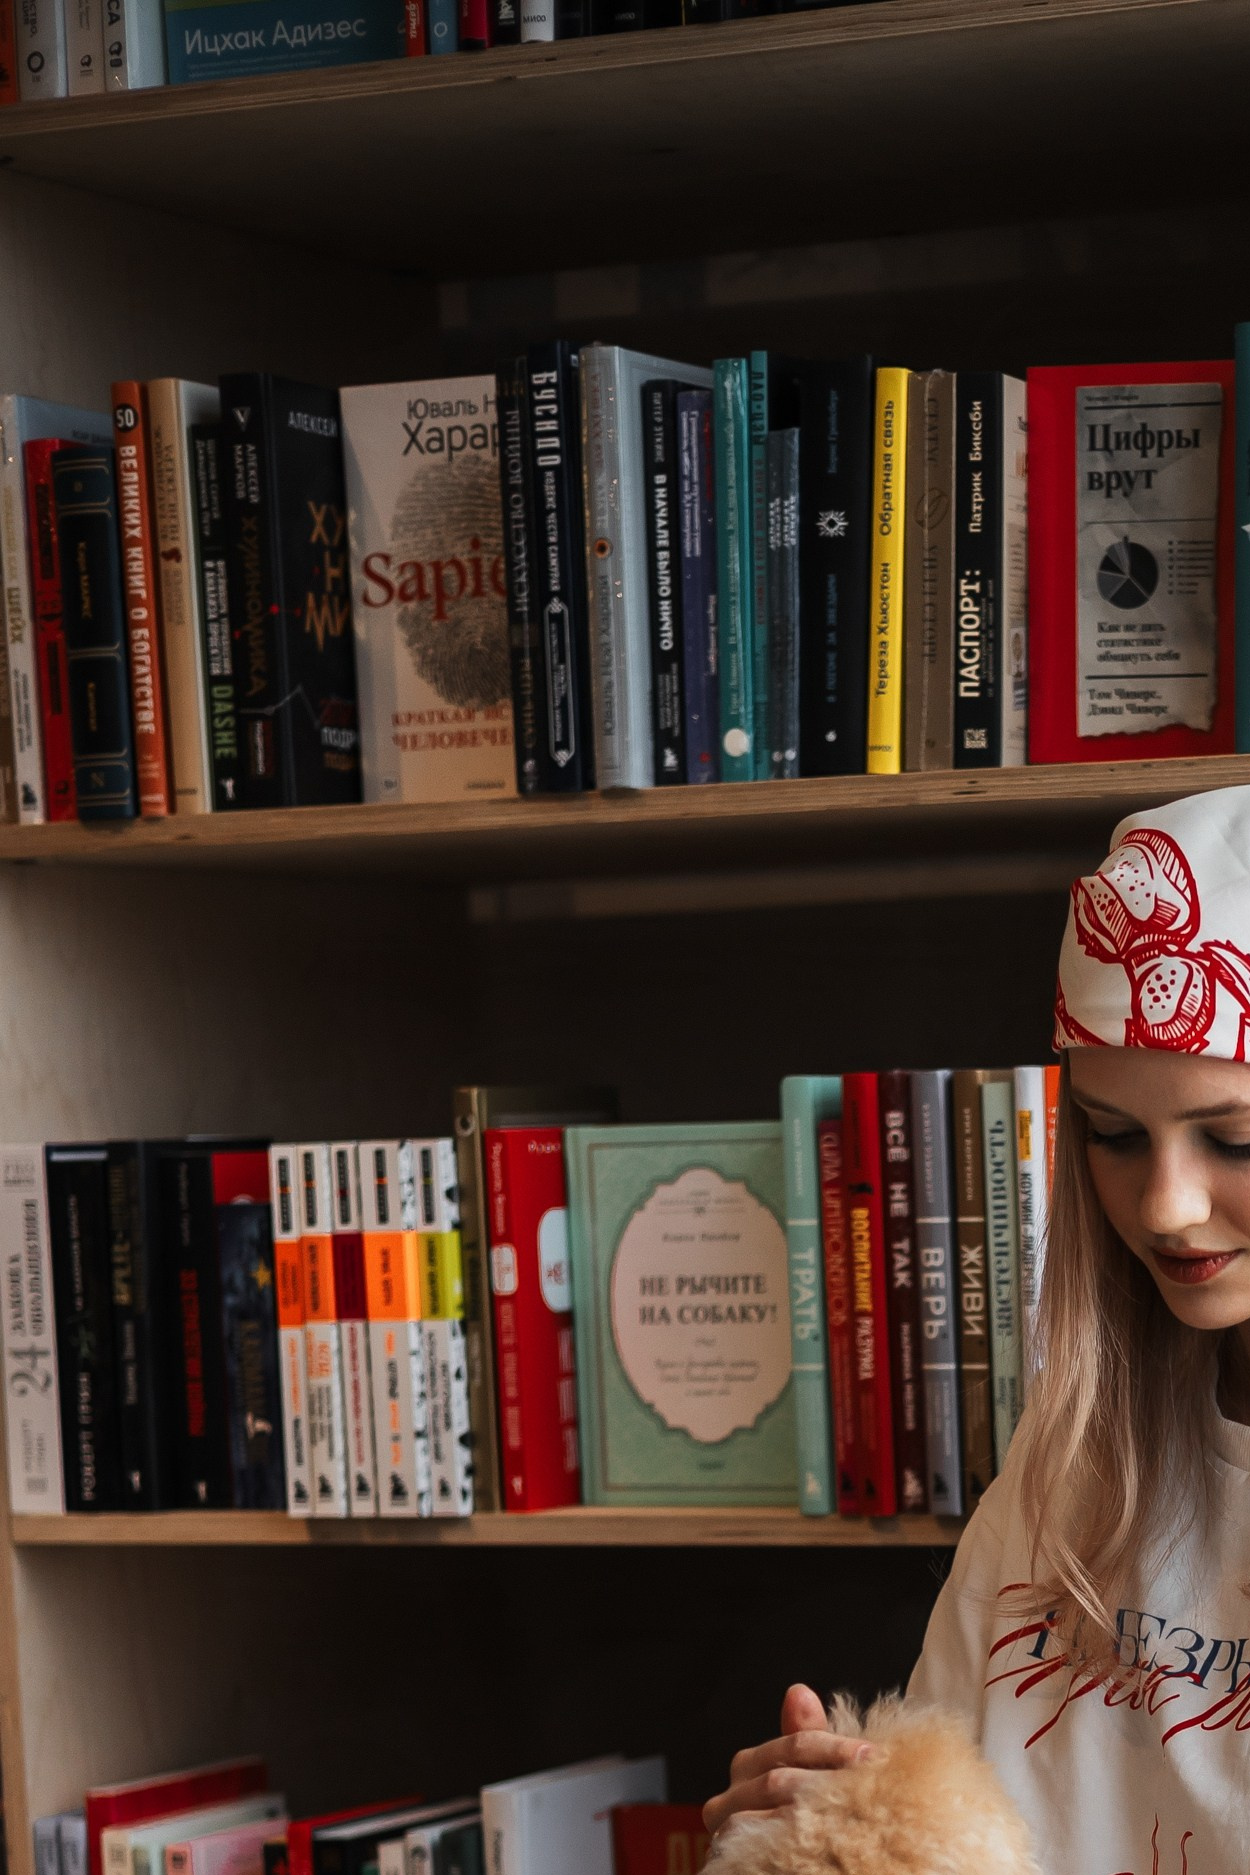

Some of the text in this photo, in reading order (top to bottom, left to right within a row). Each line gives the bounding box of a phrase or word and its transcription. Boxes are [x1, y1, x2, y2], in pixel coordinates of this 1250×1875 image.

[184, 18, 367, 57] Ицхак Адизес
[406, 398, 479, 421] Юваль
[531, 370, 561, 466] БУСИДО
[1086, 422, 1201, 458] Цифры
[234, 443, 246, 500] МАРКОВ
[246, 443, 259, 504] АЛЕКСЕЙ
[653, 474, 668, 484] В
[879, 400, 895, 536] Обратная связь
[967, 400, 985, 533] Патрик Биксби
[1086, 469, 1159, 498] врут
[505, 409, 531, 613] ИСКУССТВО ВОЙНЫ
[654, 488, 670, 547] НАЧАЛЕ
[115, 407, 156, 736] 50 ВЕЛИКИХ КНИГ О БОГАТСТВЕ
[656, 551, 671, 598] БЫЛО
[659, 601, 673, 651] НИЧТО
[875, 563, 891, 698] Тереза Хьюстон
[958, 570, 982, 698] ПАСПОРТ:
[1097, 622, 1121, 633] Как
[212, 685, 237, 760] DASHE
[821, 1132, 842, 1181] СИЛА
[885, 1110, 912, 1288] ВСЁ НЕ ТАК
[639, 1273, 768, 1297] НЕ РЫЧИТЕ
[850, 1207, 873, 1313] ВОСПИТАНИЕ
[960, 1245, 985, 1335] ЖИВИ
[639, 1303, 778, 1326] НА СОБАКУ!
[793, 1247, 818, 1340] ТРАТЬ
[921, 1246, 948, 1339] ВЕРЬ
[8, 1344, 52, 1398] 24
[854, 1315, 875, 1380] РАЗУМА
